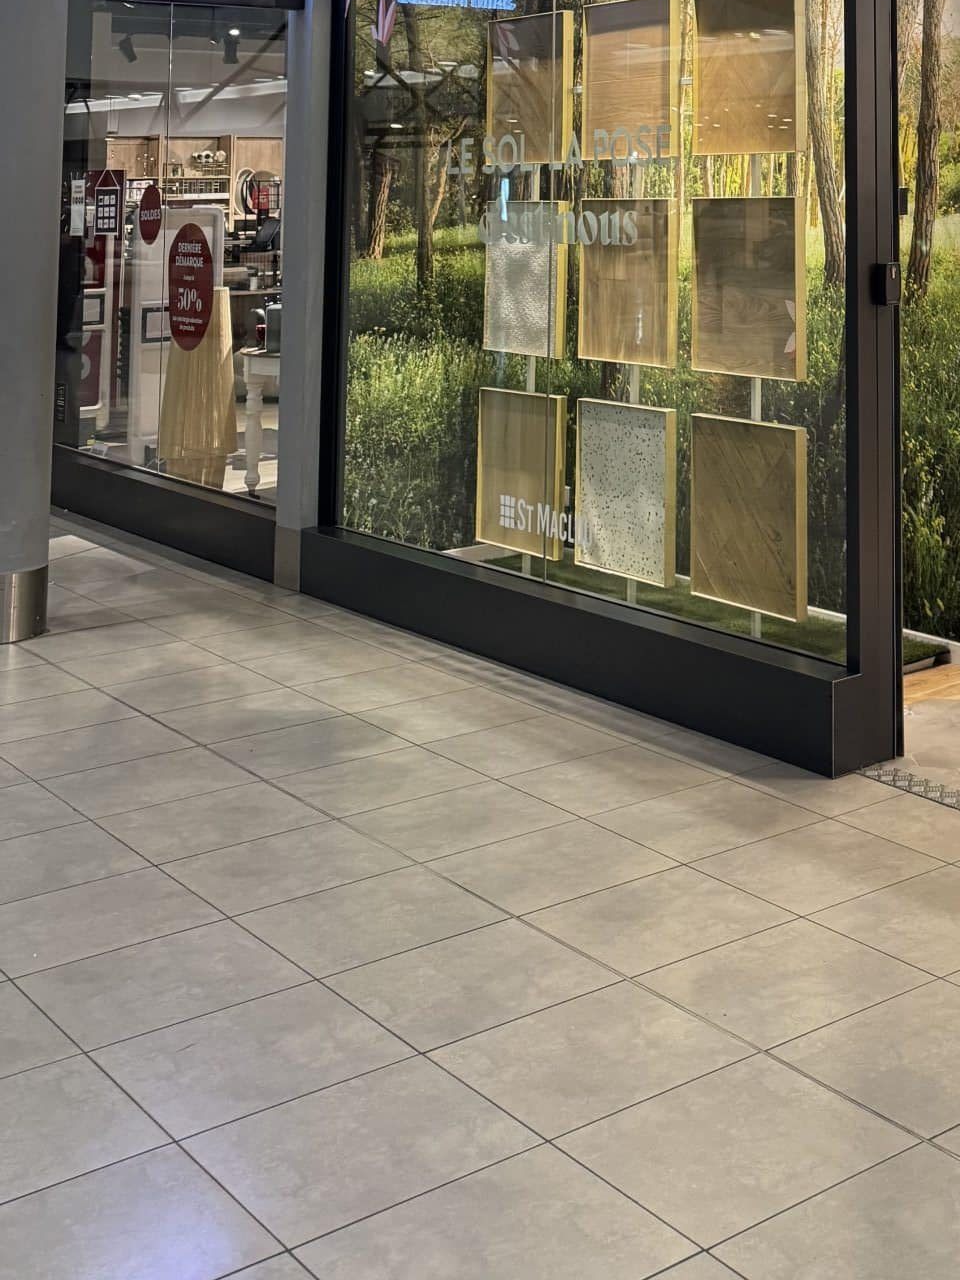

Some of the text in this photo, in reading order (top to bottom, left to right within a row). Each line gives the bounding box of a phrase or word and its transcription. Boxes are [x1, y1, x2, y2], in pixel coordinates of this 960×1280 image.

[447, 137, 475, 175] LE
[549, 130, 584, 170] LA
[593, 123, 672, 169] POSE
[139, 208, 162, 221] SOLDES
[555, 208, 639, 247] nous
[517, 498, 535, 533] ST
